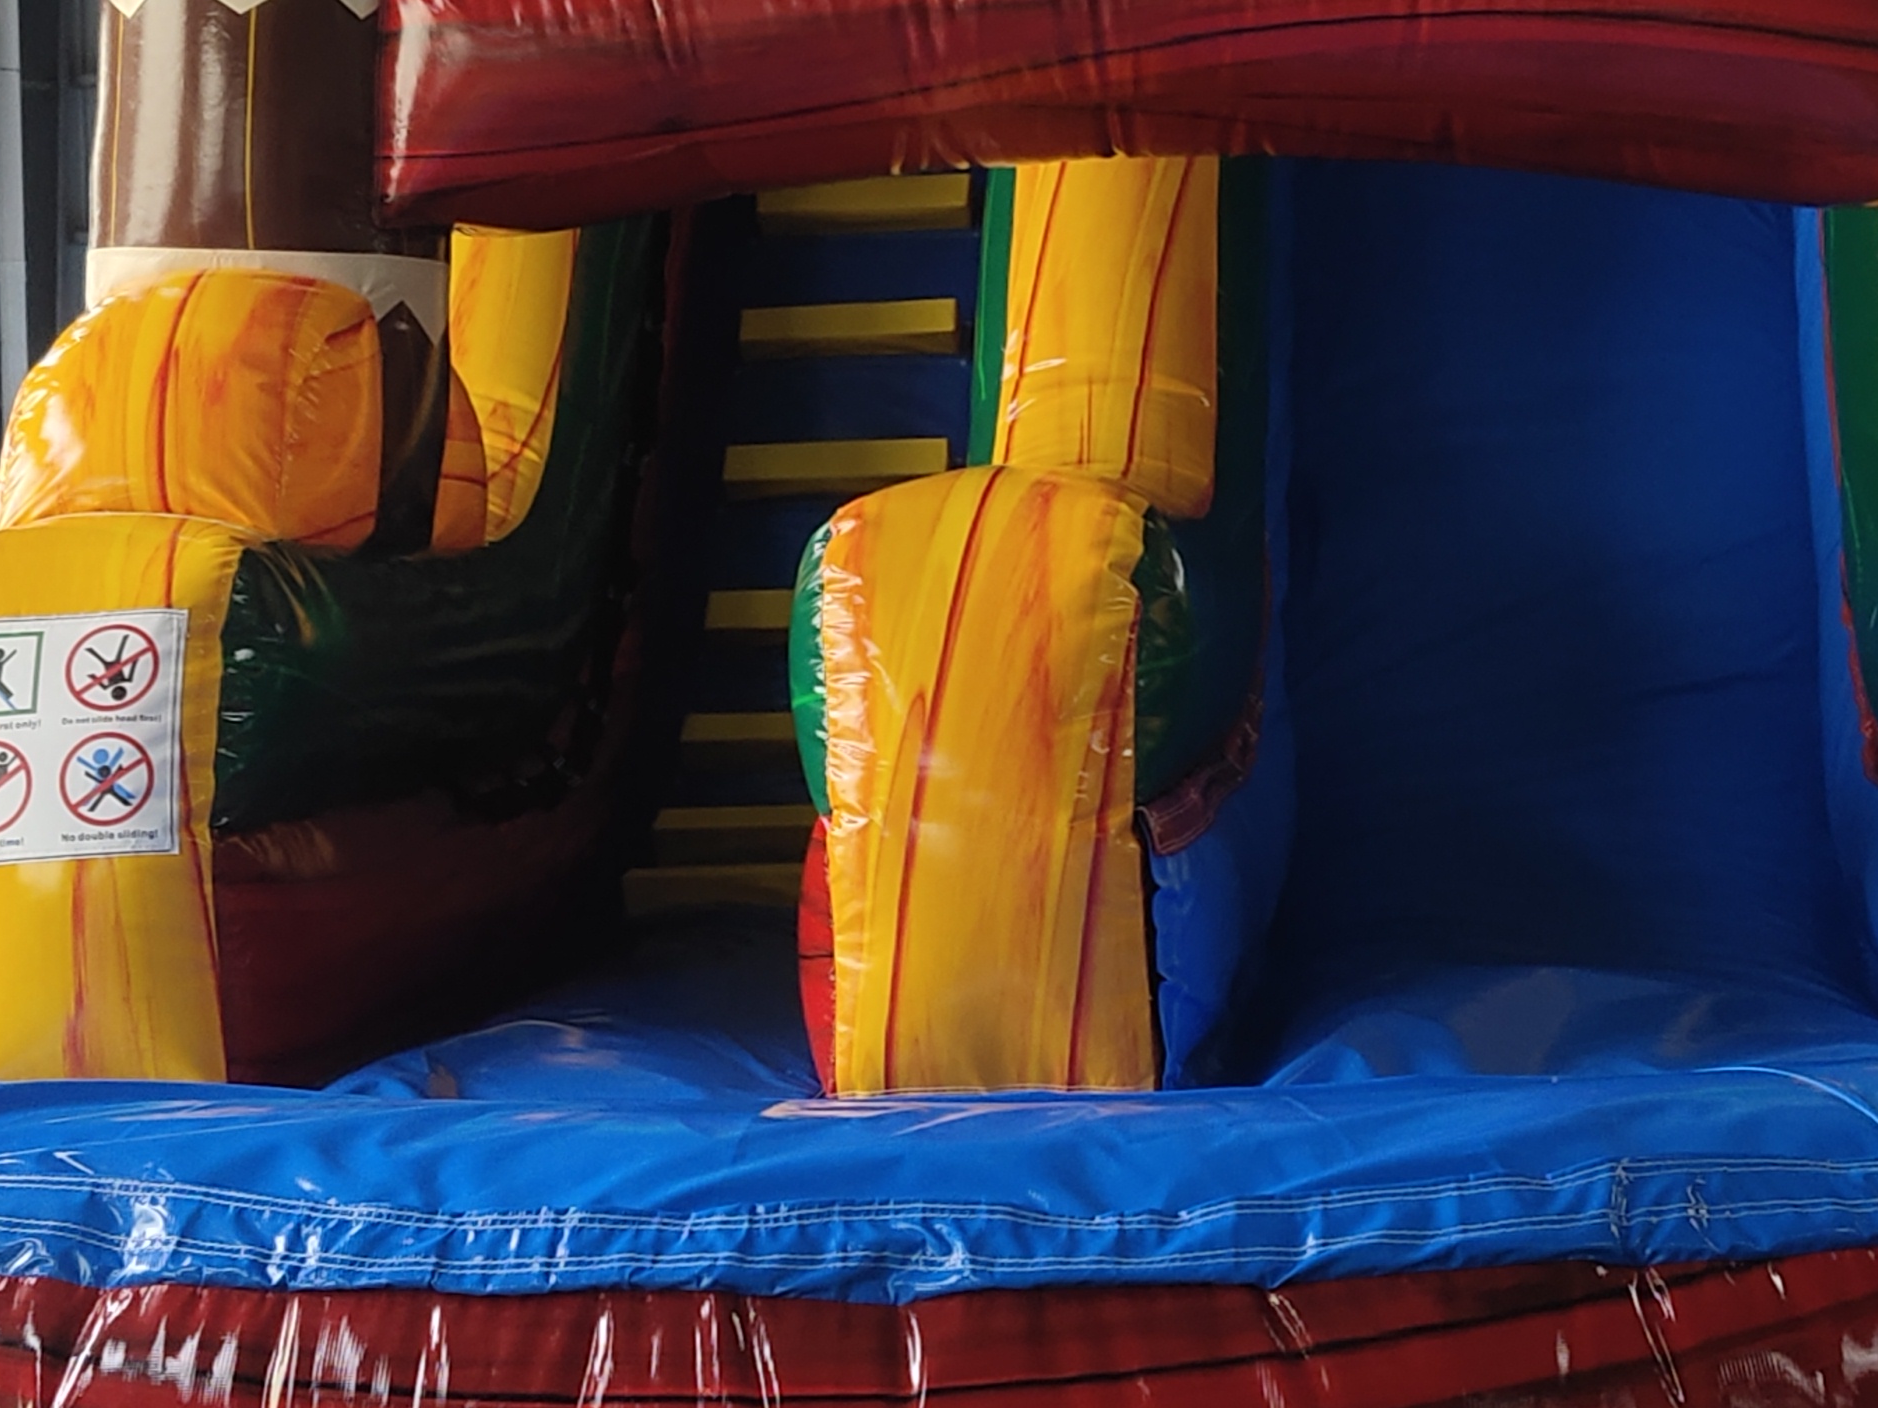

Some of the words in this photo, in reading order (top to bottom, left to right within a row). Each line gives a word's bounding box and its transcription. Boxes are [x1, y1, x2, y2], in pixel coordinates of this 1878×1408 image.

[15, 718, 42, 730] only!
[61, 717, 73, 725] Do
[92, 715, 113, 723] slide
[115, 714, 137, 722] head
[61, 833, 76, 842] No
[78, 831, 115, 841] double
[117, 828, 159, 840] sliding!
[0, 837, 25, 848] time!
